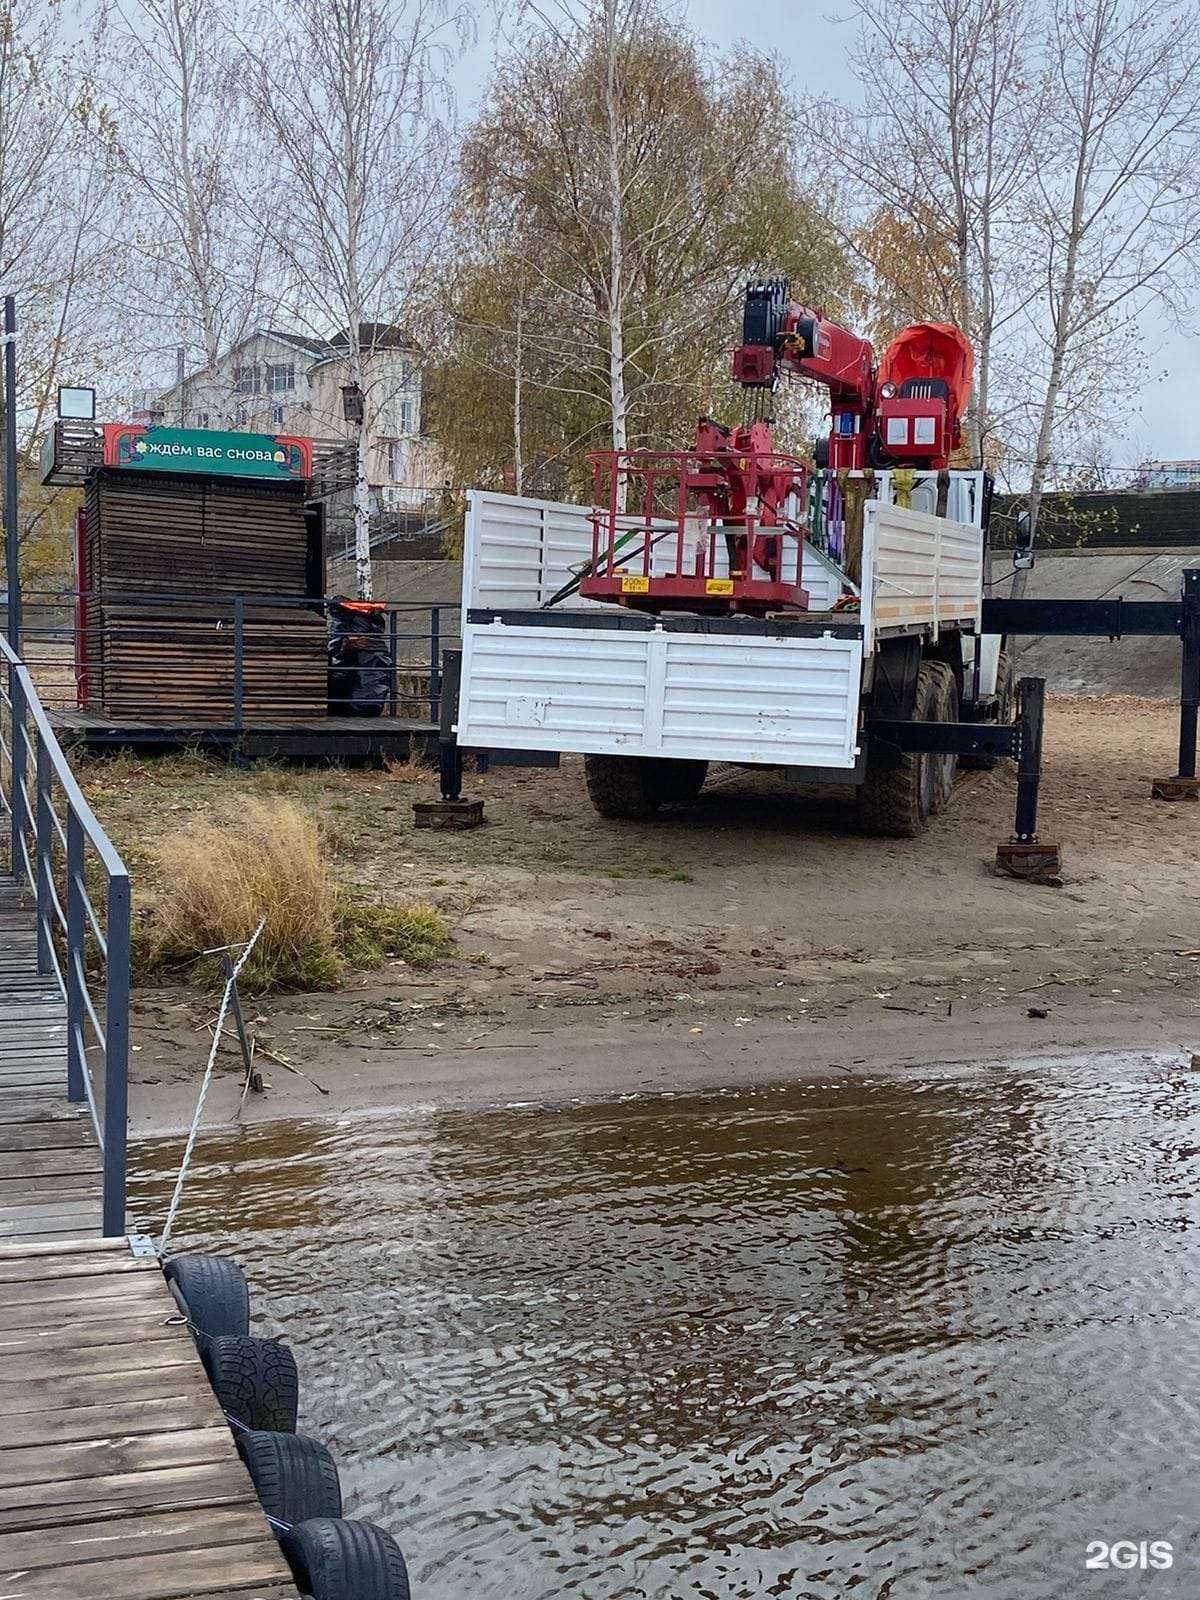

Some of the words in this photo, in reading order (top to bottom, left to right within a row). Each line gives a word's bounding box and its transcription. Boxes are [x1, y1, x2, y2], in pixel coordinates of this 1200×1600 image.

[149, 443, 192, 456] ждём
[197, 445, 222, 458] вас
[227, 449, 272, 461] снова
